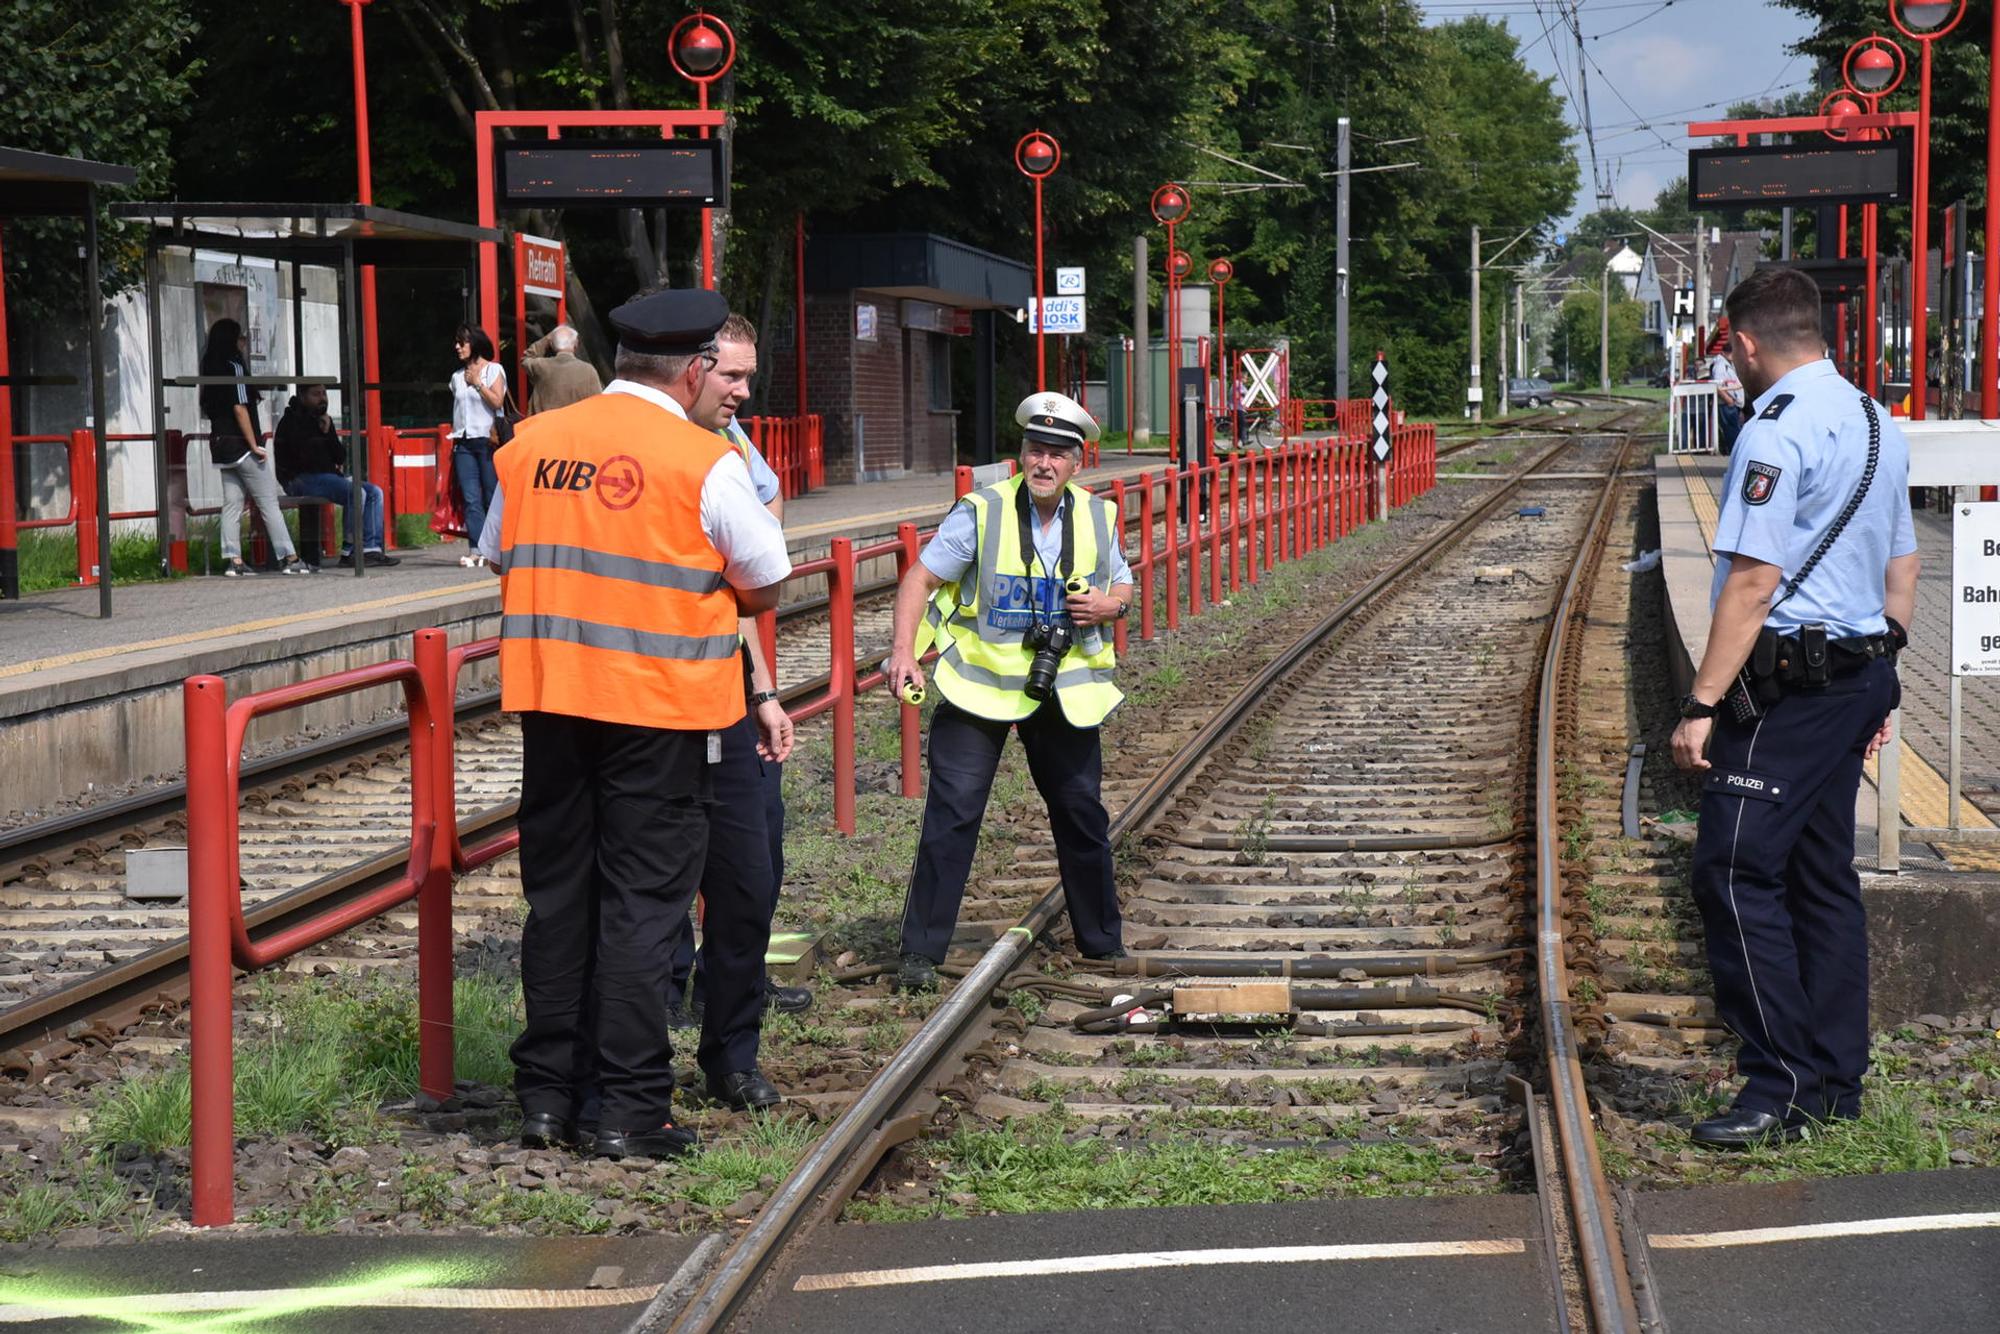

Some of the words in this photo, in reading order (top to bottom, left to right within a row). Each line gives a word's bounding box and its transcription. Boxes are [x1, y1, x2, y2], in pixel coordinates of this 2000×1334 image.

[528, 248, 557, 284] Refrath
[1034, 300, 1080, 312] ddi's
[1674, 290, 1695, 314] H
[533, 458, 597, 491] KVB
[1983, 539, 2000, 556] Be
[992, 577, 1068, 609] POLI
[1963, 586, 2000, 603] Bah
[1980, 635, 2000, 652] ge
[1726, 774, 1764, 790] POLIZEI
